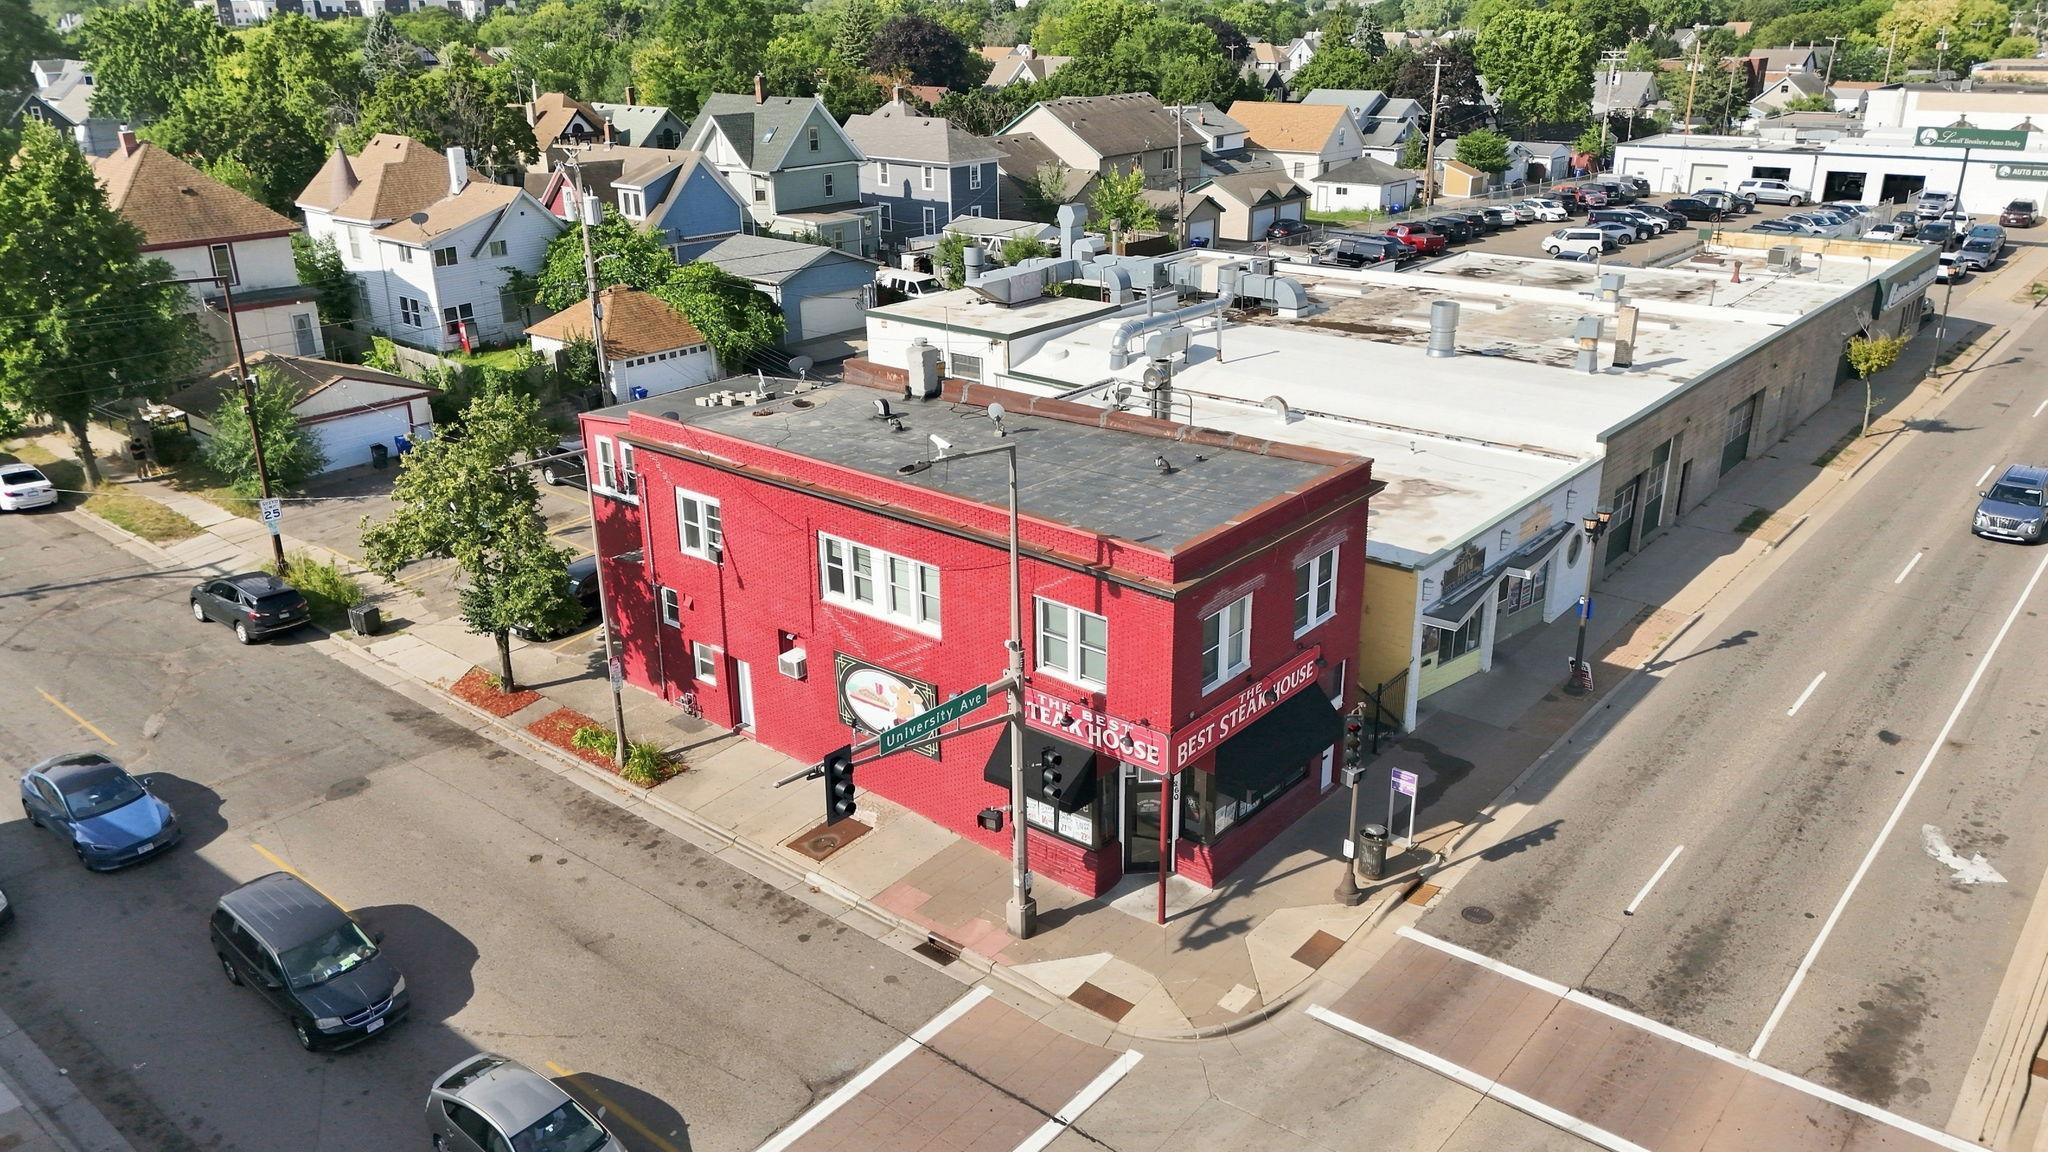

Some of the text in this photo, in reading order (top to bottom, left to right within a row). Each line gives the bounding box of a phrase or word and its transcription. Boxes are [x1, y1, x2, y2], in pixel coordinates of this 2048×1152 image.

[2012, 168, 2031, 176] AUTO
[264, 508, 281, 520] 25
[1036, 693, 1134, 733] THE BEST
[1238, 682, 1262, 704] THE
[886, 693, 982, 747] University Ave
[1024, 701, 1160, 766] TEAK HOUSE
[1177, 723, 1215, 767] BEST
[1219, 692, 1268, 739] STEAK
